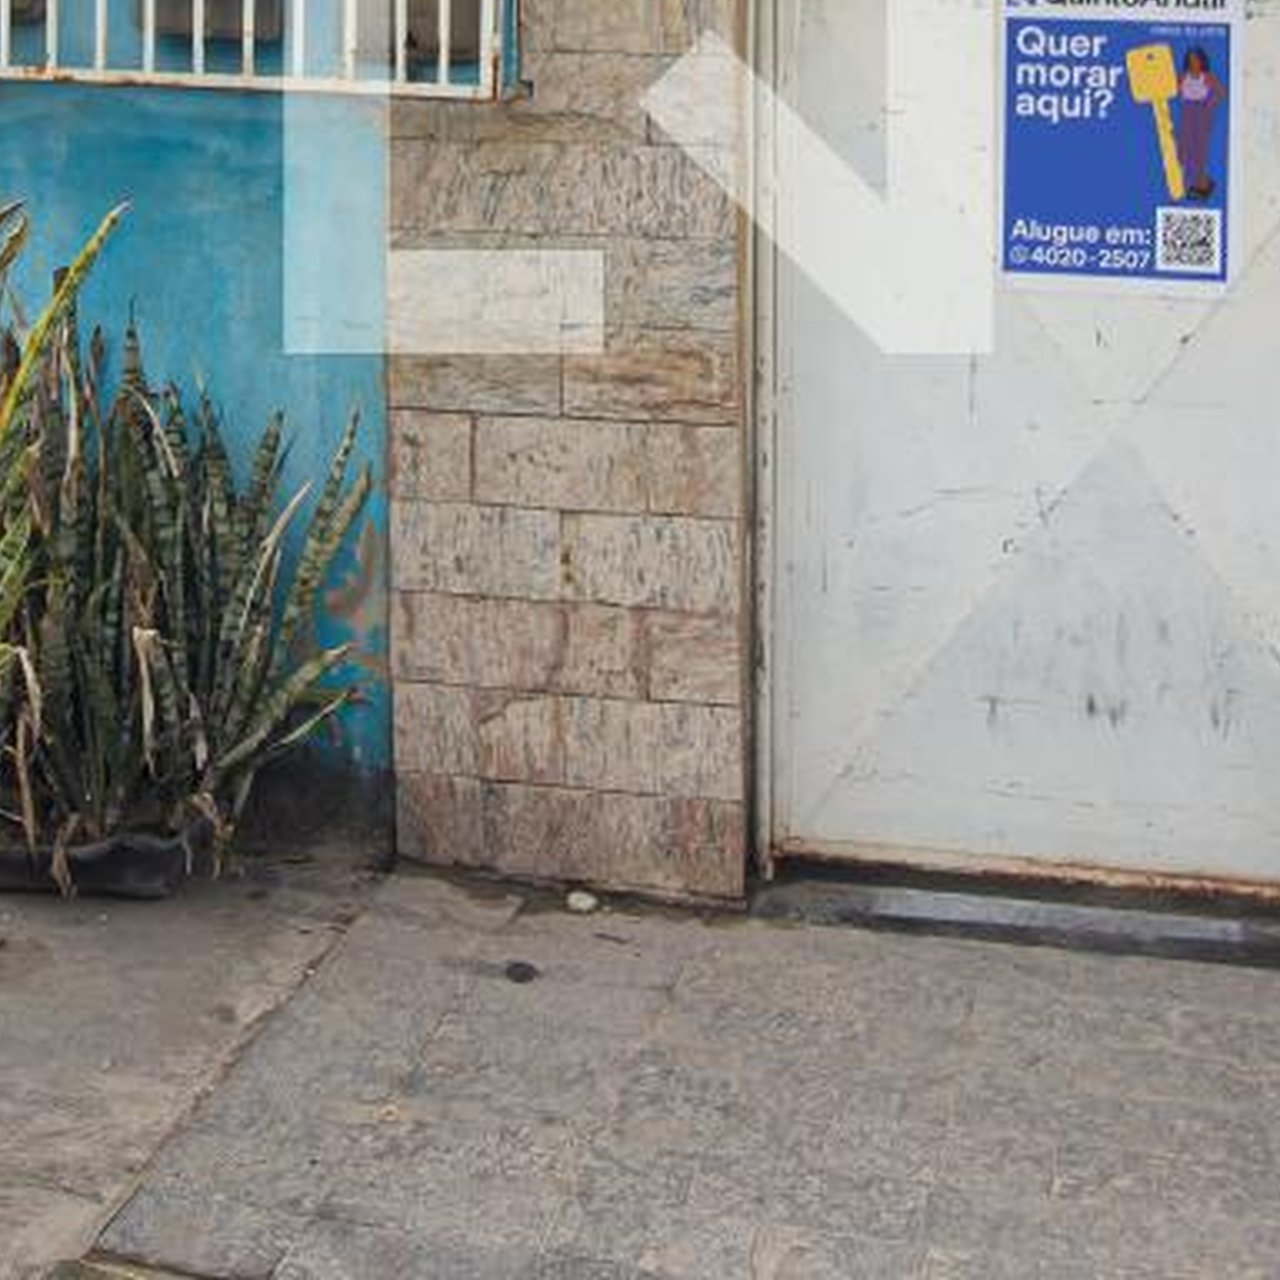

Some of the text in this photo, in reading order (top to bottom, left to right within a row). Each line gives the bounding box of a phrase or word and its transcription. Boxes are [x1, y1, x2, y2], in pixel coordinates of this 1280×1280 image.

[1016, 26, 1108, 57] Quer
[1016, 63, 1123, 88] morar
[1016, 89, 1114, 123] aqui?
[1012, 219, 1152, 245] Alugue em:
[1031, 245, 1150, 268] 4020-2507
